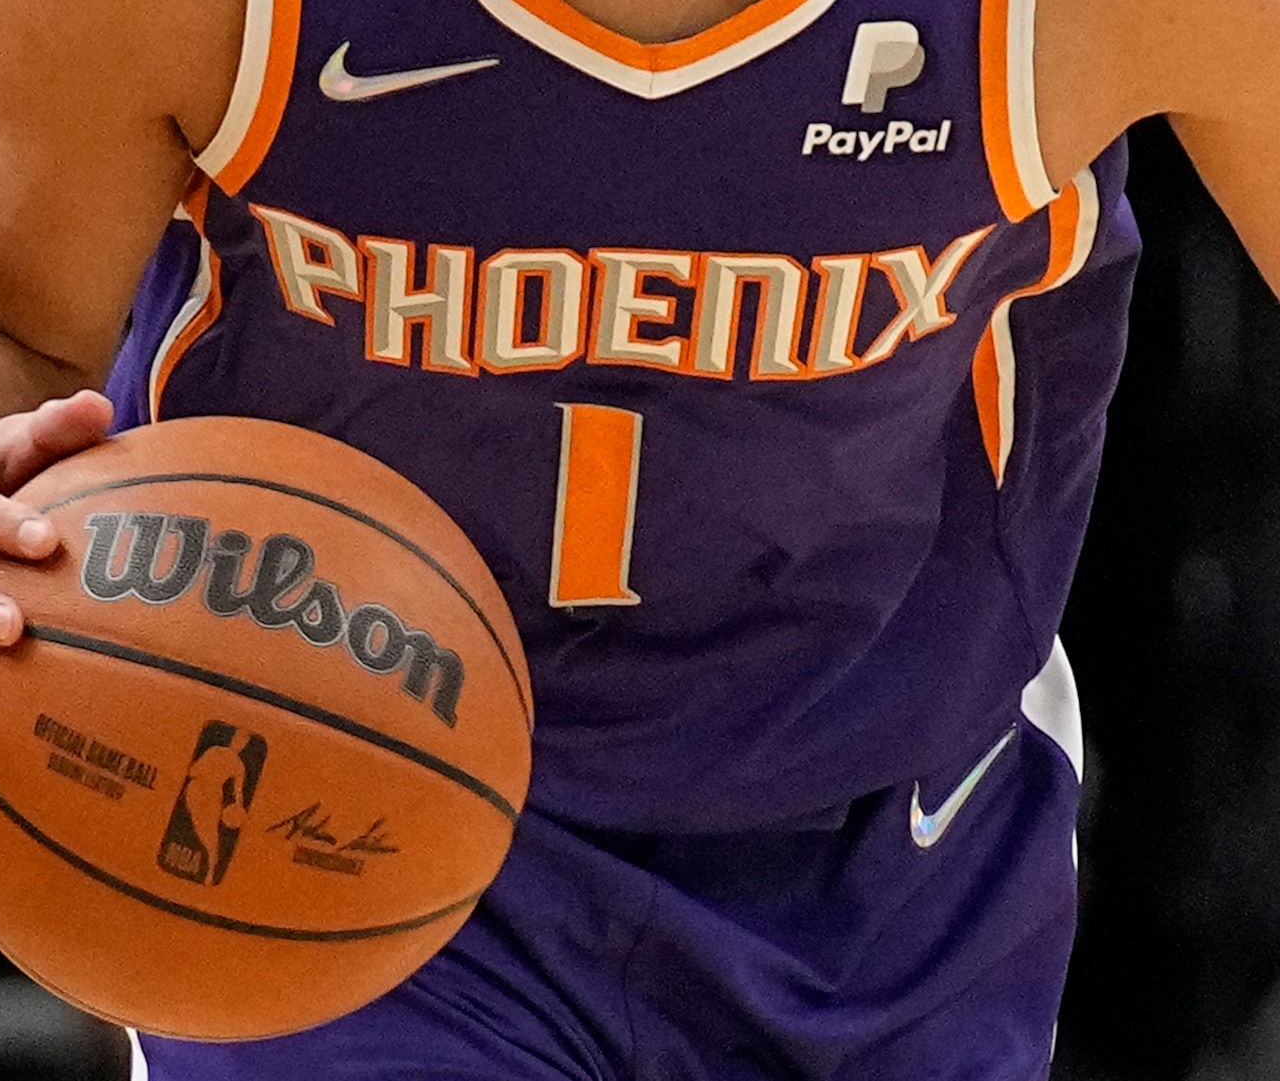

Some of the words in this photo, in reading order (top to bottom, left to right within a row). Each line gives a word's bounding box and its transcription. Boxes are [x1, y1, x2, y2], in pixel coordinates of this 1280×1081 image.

[801, 119, 952, 162] PayPal
[248, 203, 997, 381] PHOENIX
[550, 402, 642, 607] 1
[79, 511, 466, 729] Wilson
